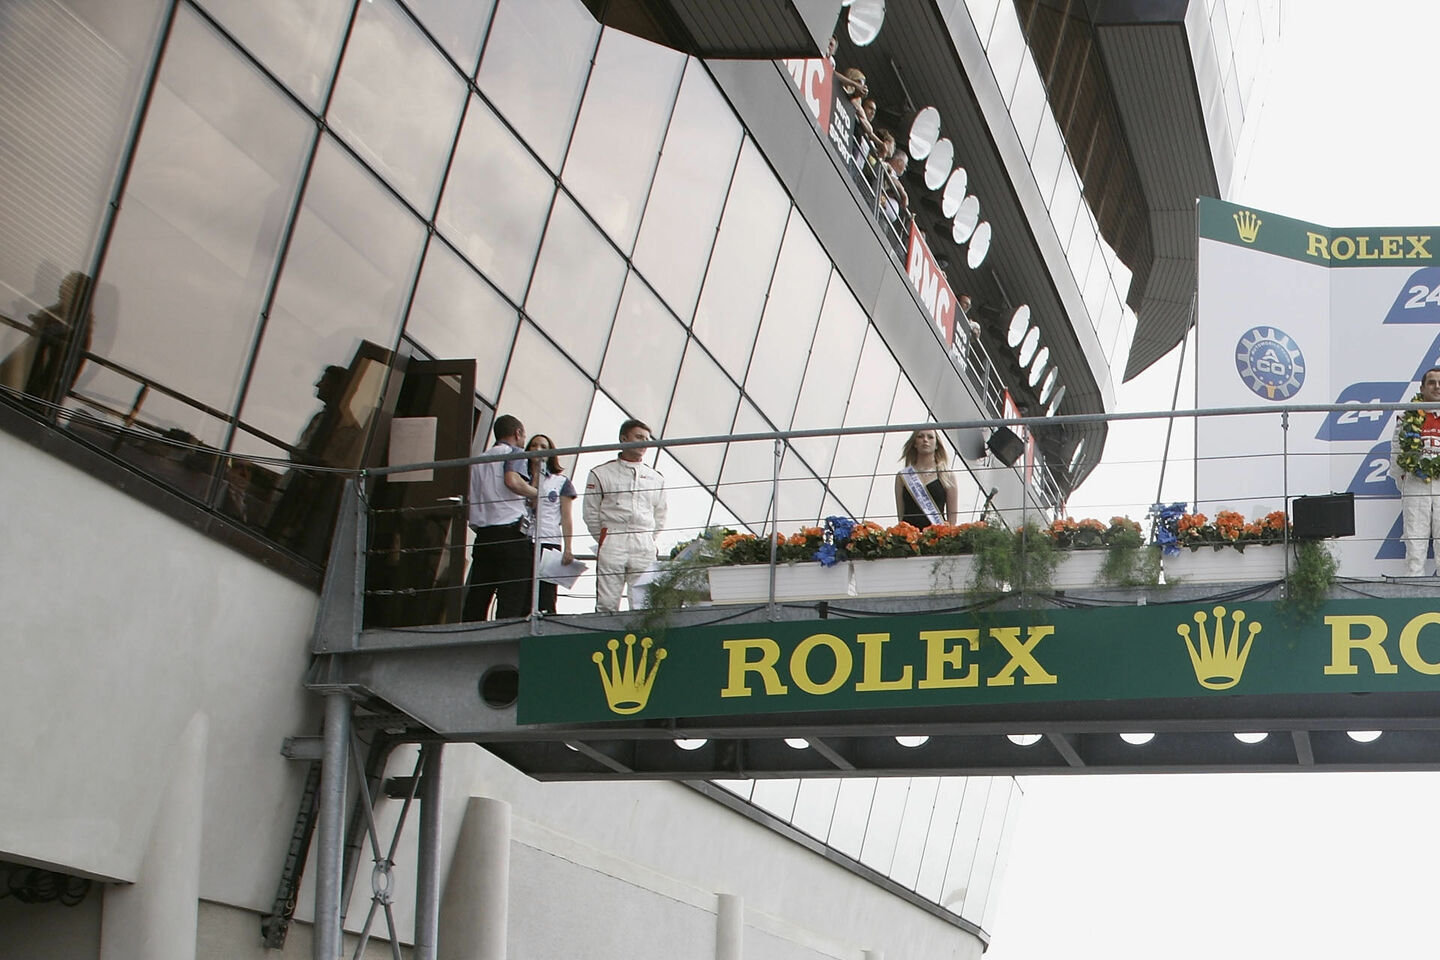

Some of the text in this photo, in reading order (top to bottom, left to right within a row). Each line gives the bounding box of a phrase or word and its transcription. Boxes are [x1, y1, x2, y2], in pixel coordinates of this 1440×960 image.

[1306, 231, 1432, 259] ROLEX
[911, 230, 951, 341] RMC
[1365, 458, 1391, 483] 2
[722, 625, 1057, 698] ROLEX
